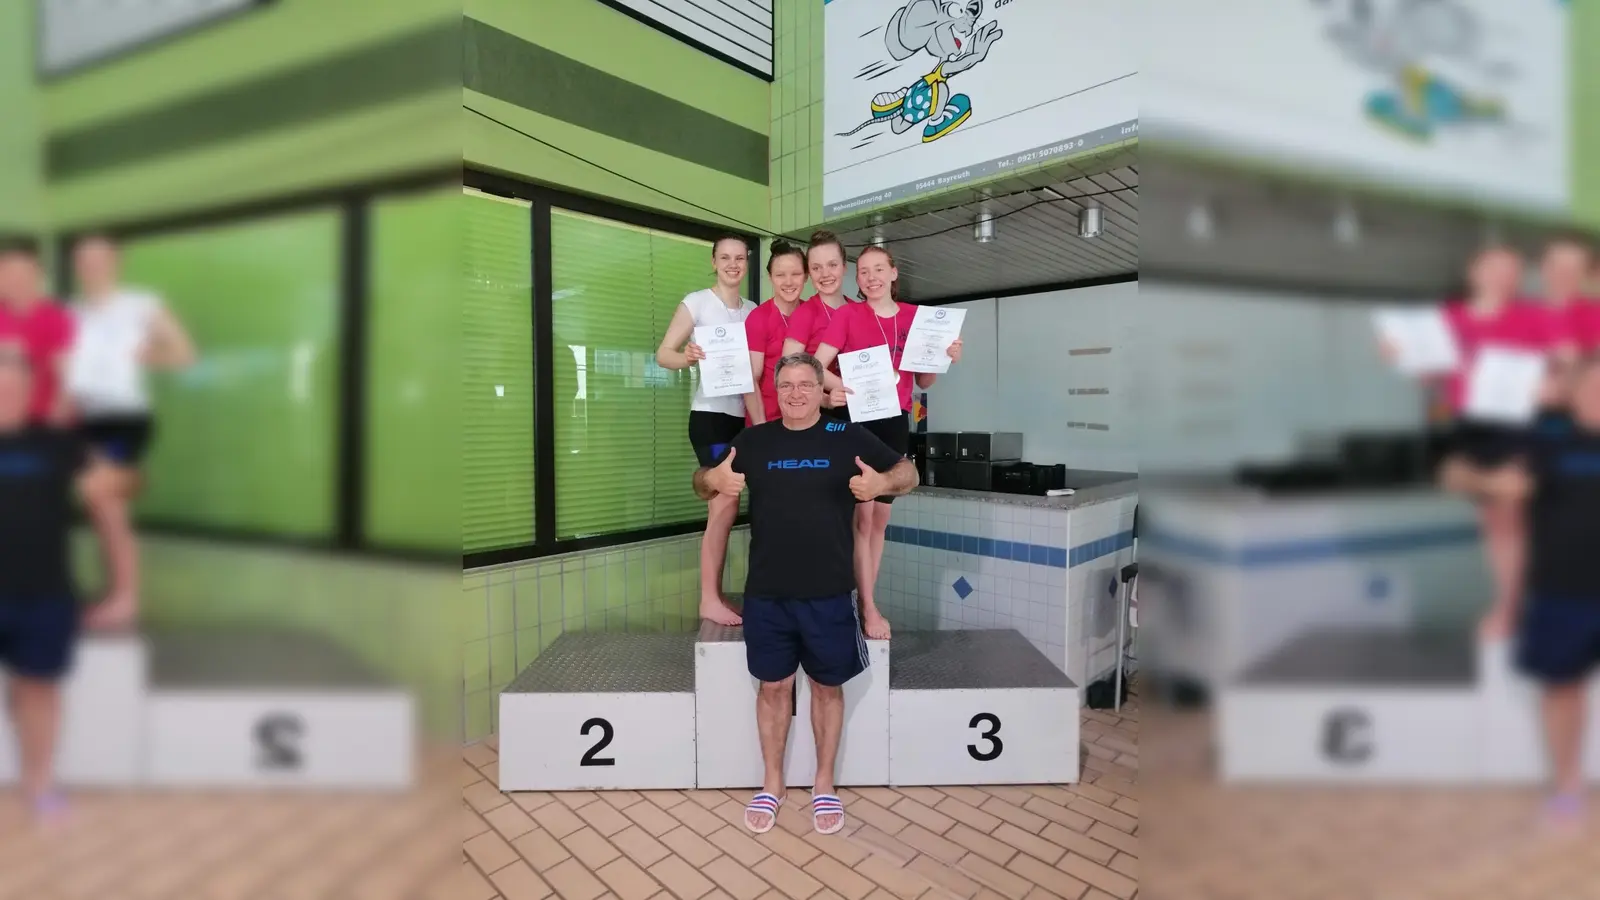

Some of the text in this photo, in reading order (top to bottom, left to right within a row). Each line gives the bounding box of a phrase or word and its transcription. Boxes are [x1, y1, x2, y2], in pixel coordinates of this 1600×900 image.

[995, 0, 1013, 8] da
[884, 191, 893, 199] 40
[937, 170, 971, 185] Bayreuth
[768, 459, 829, 470] HEAD
[580, 717, 615, 766] 2
[967, 712, 1003, 761] 3
